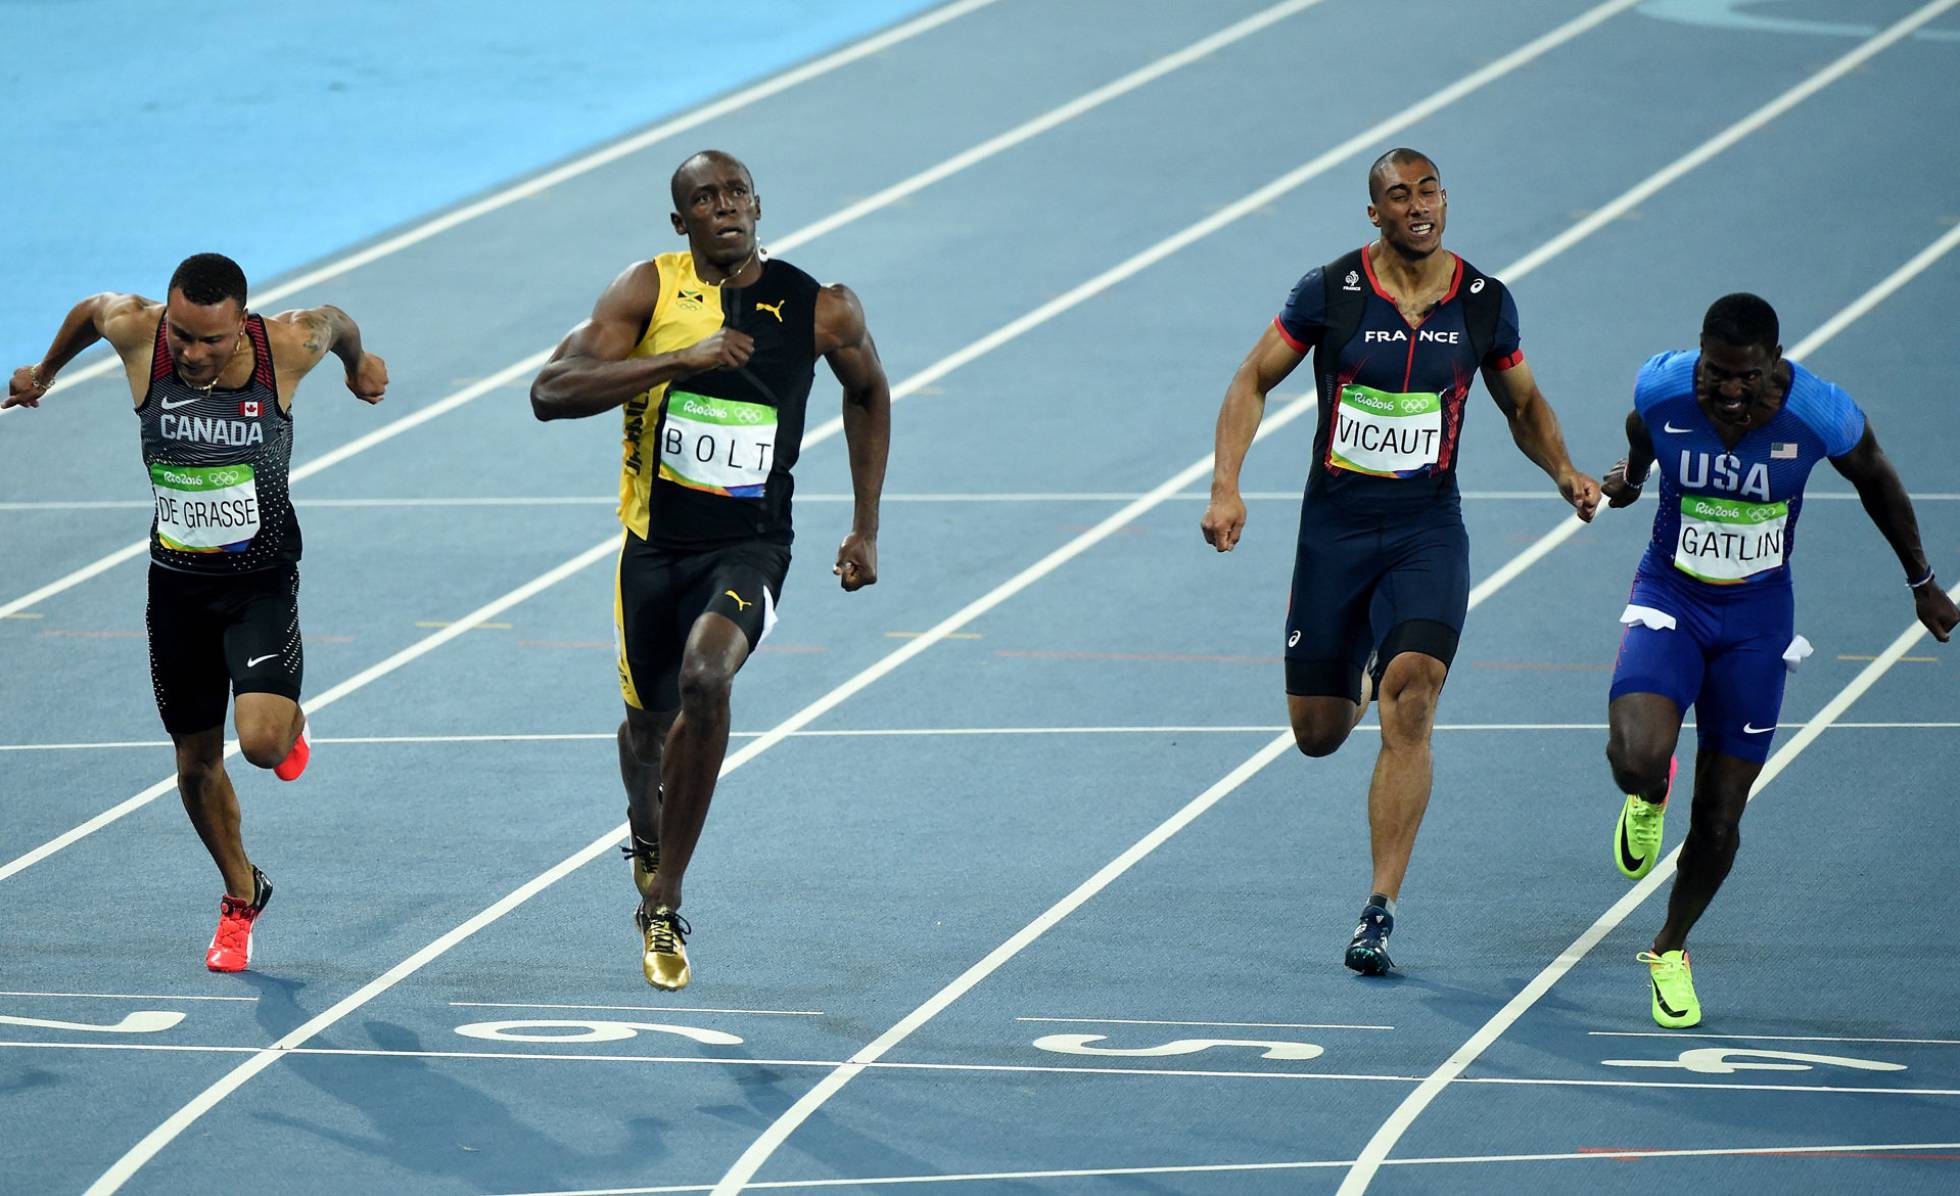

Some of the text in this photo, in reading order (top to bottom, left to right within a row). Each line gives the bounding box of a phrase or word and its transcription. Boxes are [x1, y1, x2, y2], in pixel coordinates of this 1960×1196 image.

[683, 399, 728, 419] Rio2016
[1354, 392, 1394, 411] Rio2016
[160, 414, 264, 446] CANADA
[1338, 414, 1438, 455] VICAUT
[664, 427, 771, 472] BOLT
[163, 471, 203, 486] Rio2016
[1679, 449, 1770, 502] USA
[158, 496, 257, 529] DE GRASSE
[1695, 502, 1740, 518] Rio2016
[1682, 526, 1780, 560] GATLIN
